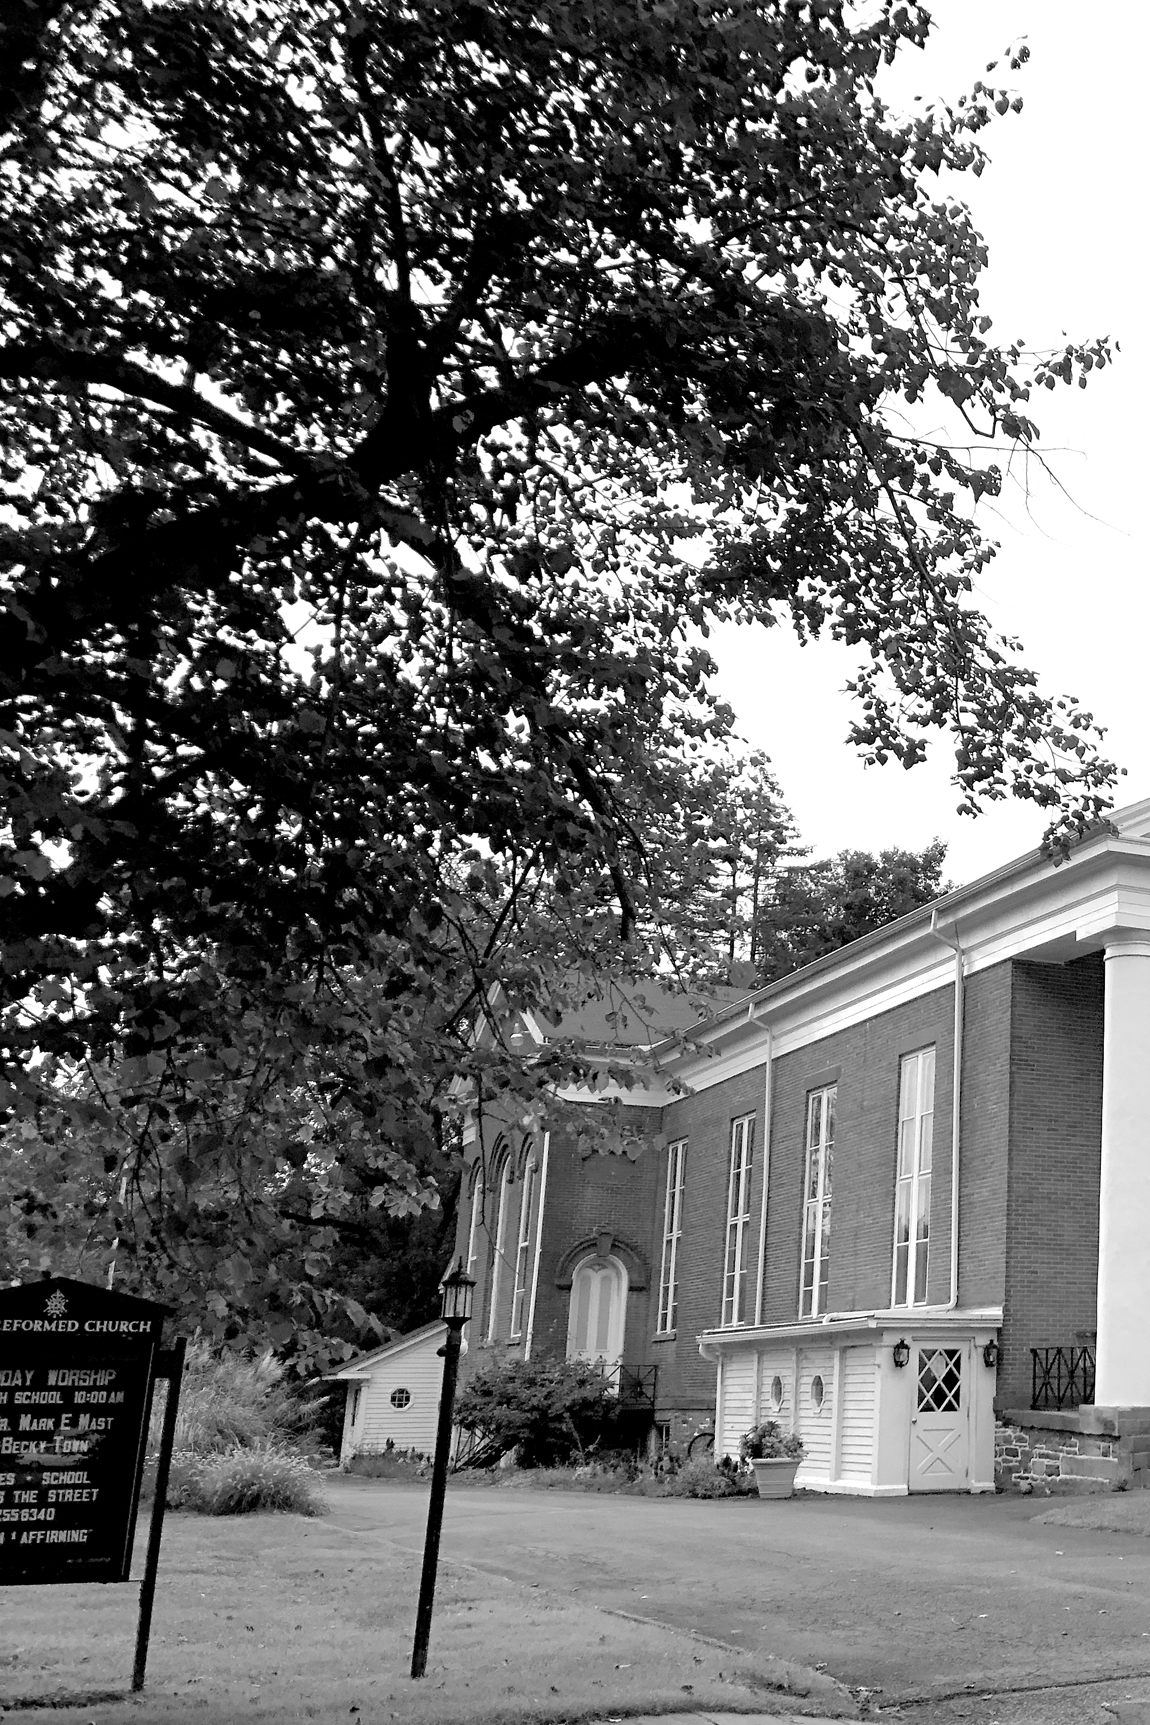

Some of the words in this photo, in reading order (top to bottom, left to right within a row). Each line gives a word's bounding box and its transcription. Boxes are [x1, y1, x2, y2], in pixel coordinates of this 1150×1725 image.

[84, 1320, 152, 1332] CHURCH
[47, 1369, 117, 1386] WORSHIP
[14, 1391, 64, 1404] SCHOOL
[60, 1413, 73, 1431] E
[42, 1471, 91, 1485] SCHOOL
[13, 1490, 39, 1503] THE
[47, 1488, 100, 1502] STREET
[20, 1529, 88, 1544] AFFIRMING
